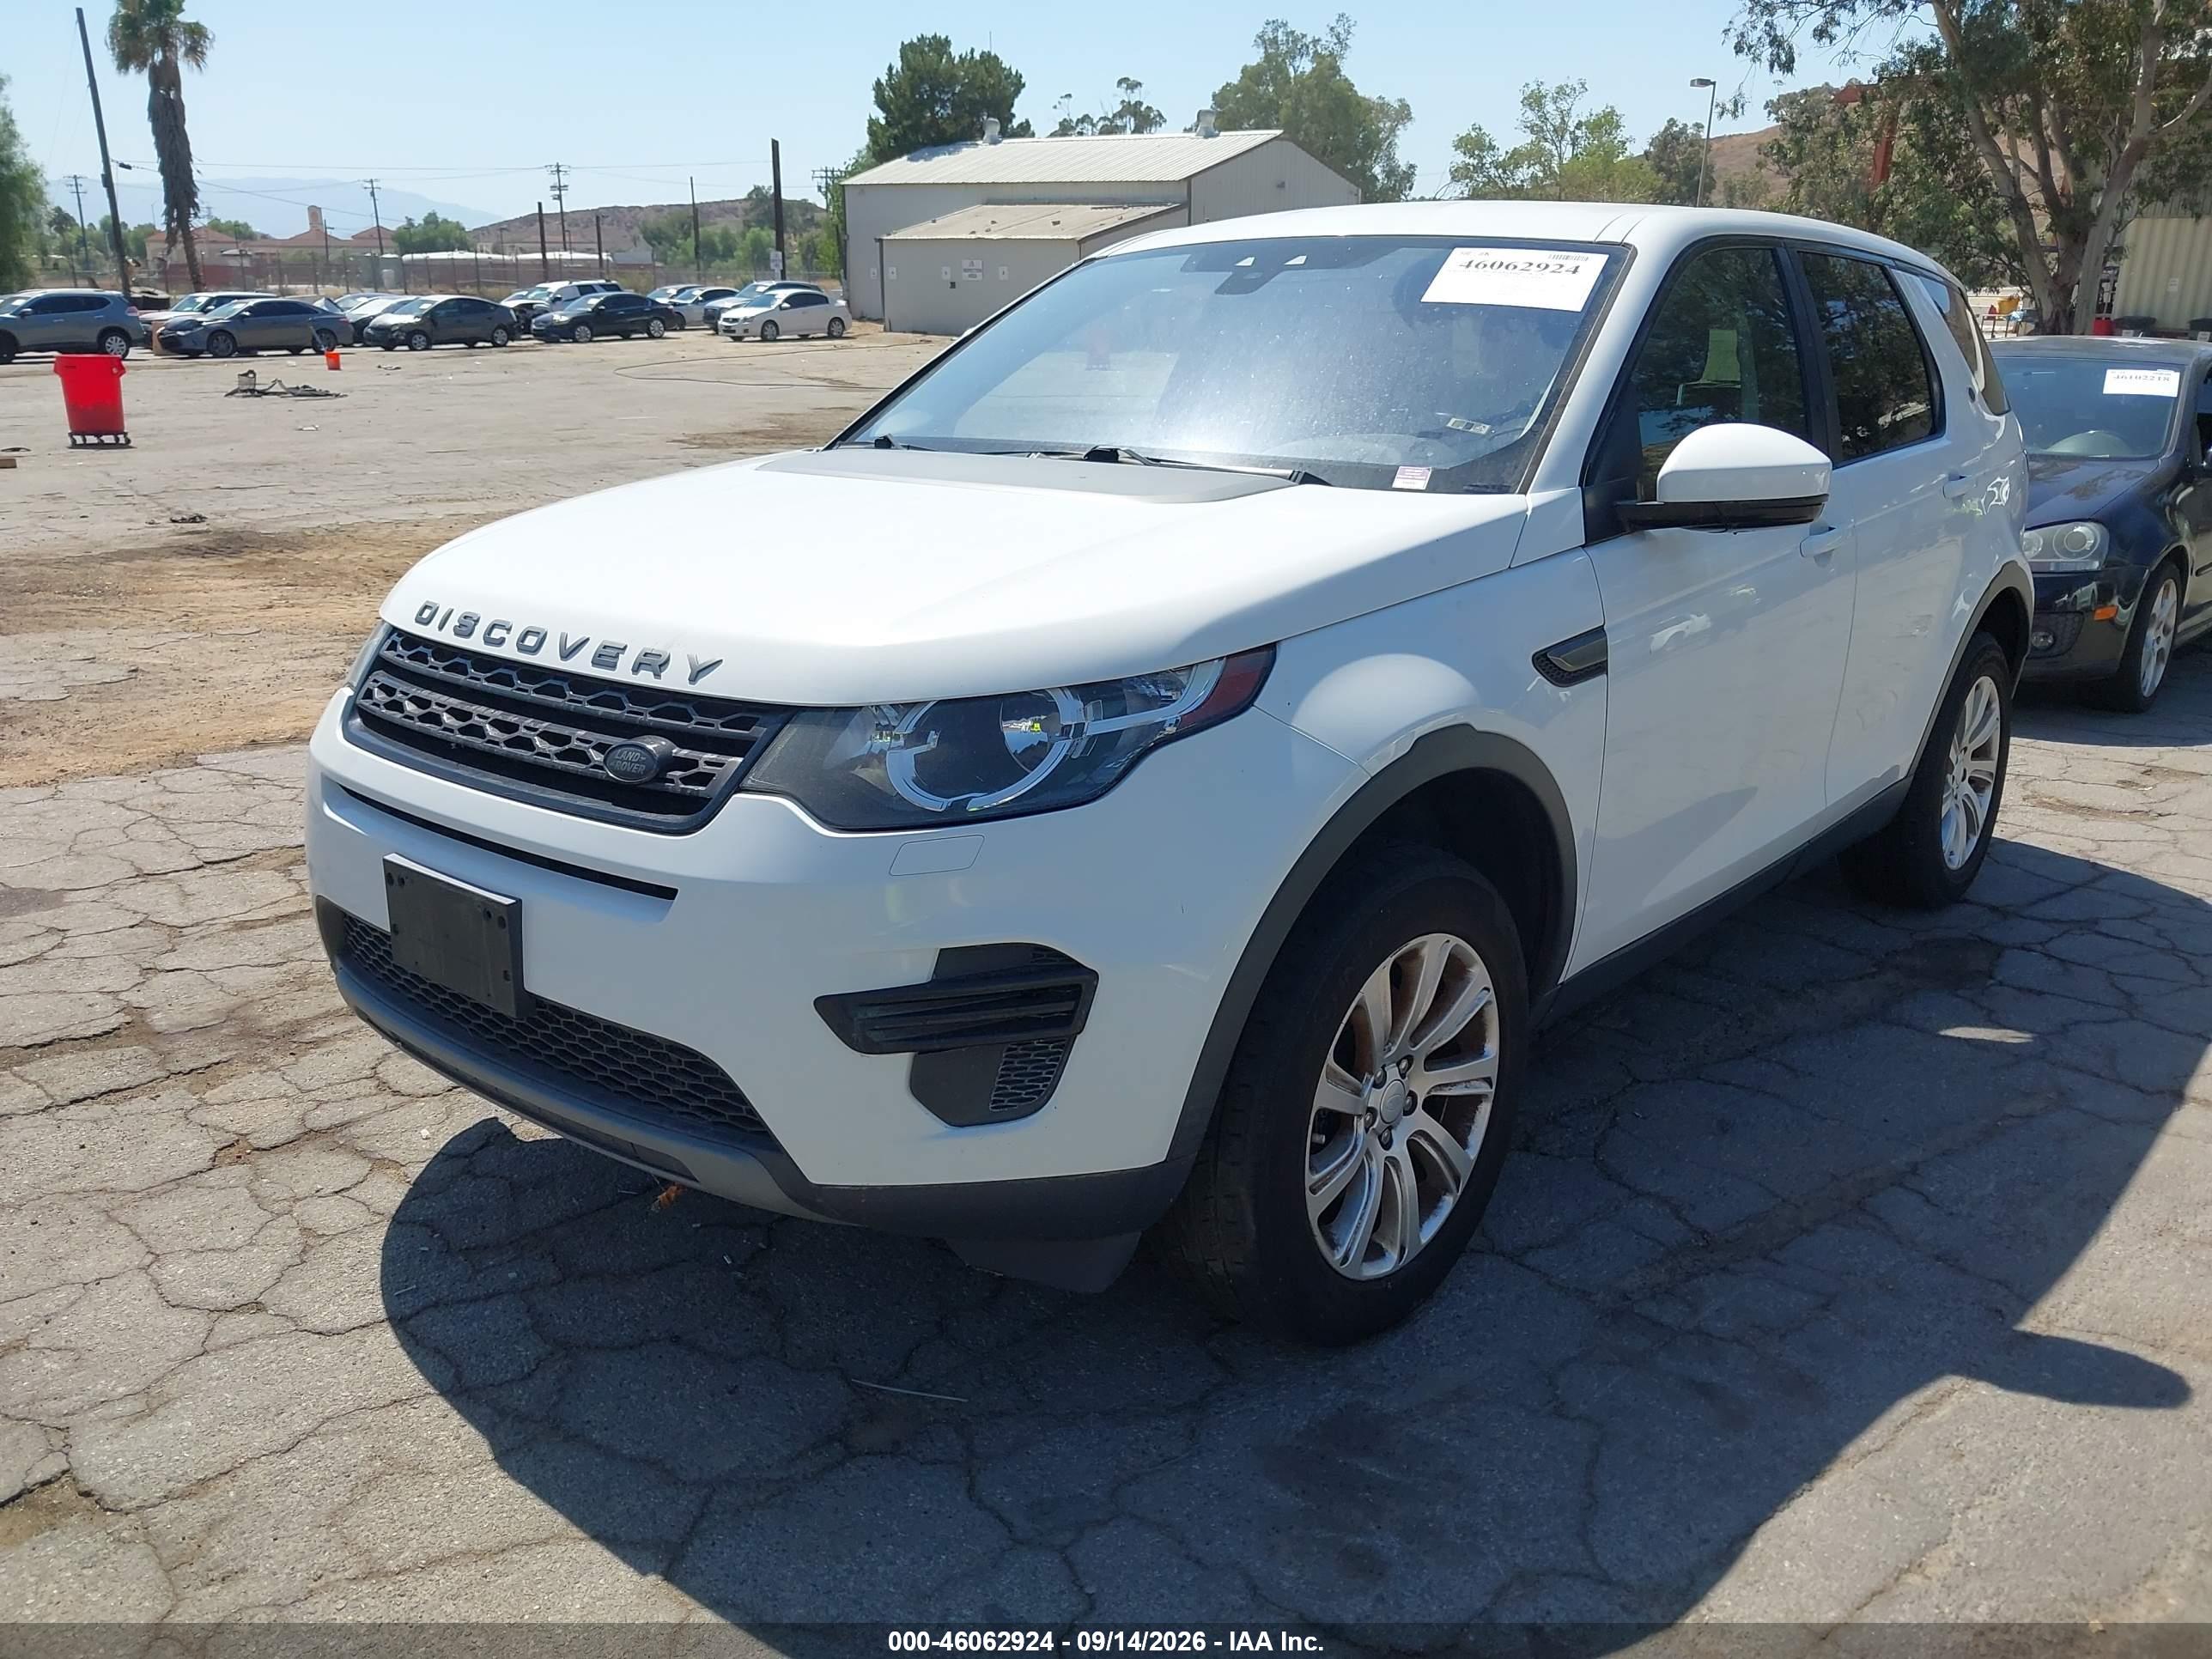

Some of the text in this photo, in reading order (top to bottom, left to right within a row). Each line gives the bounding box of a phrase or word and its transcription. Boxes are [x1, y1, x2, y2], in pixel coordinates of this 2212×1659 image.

[1458, 259, 1582, 275] 46062924
[414, 599, 724, 686] DISCOVERY
[616, 749, 641, 762] LAND
[614, 761, 646, 775] ROVER
